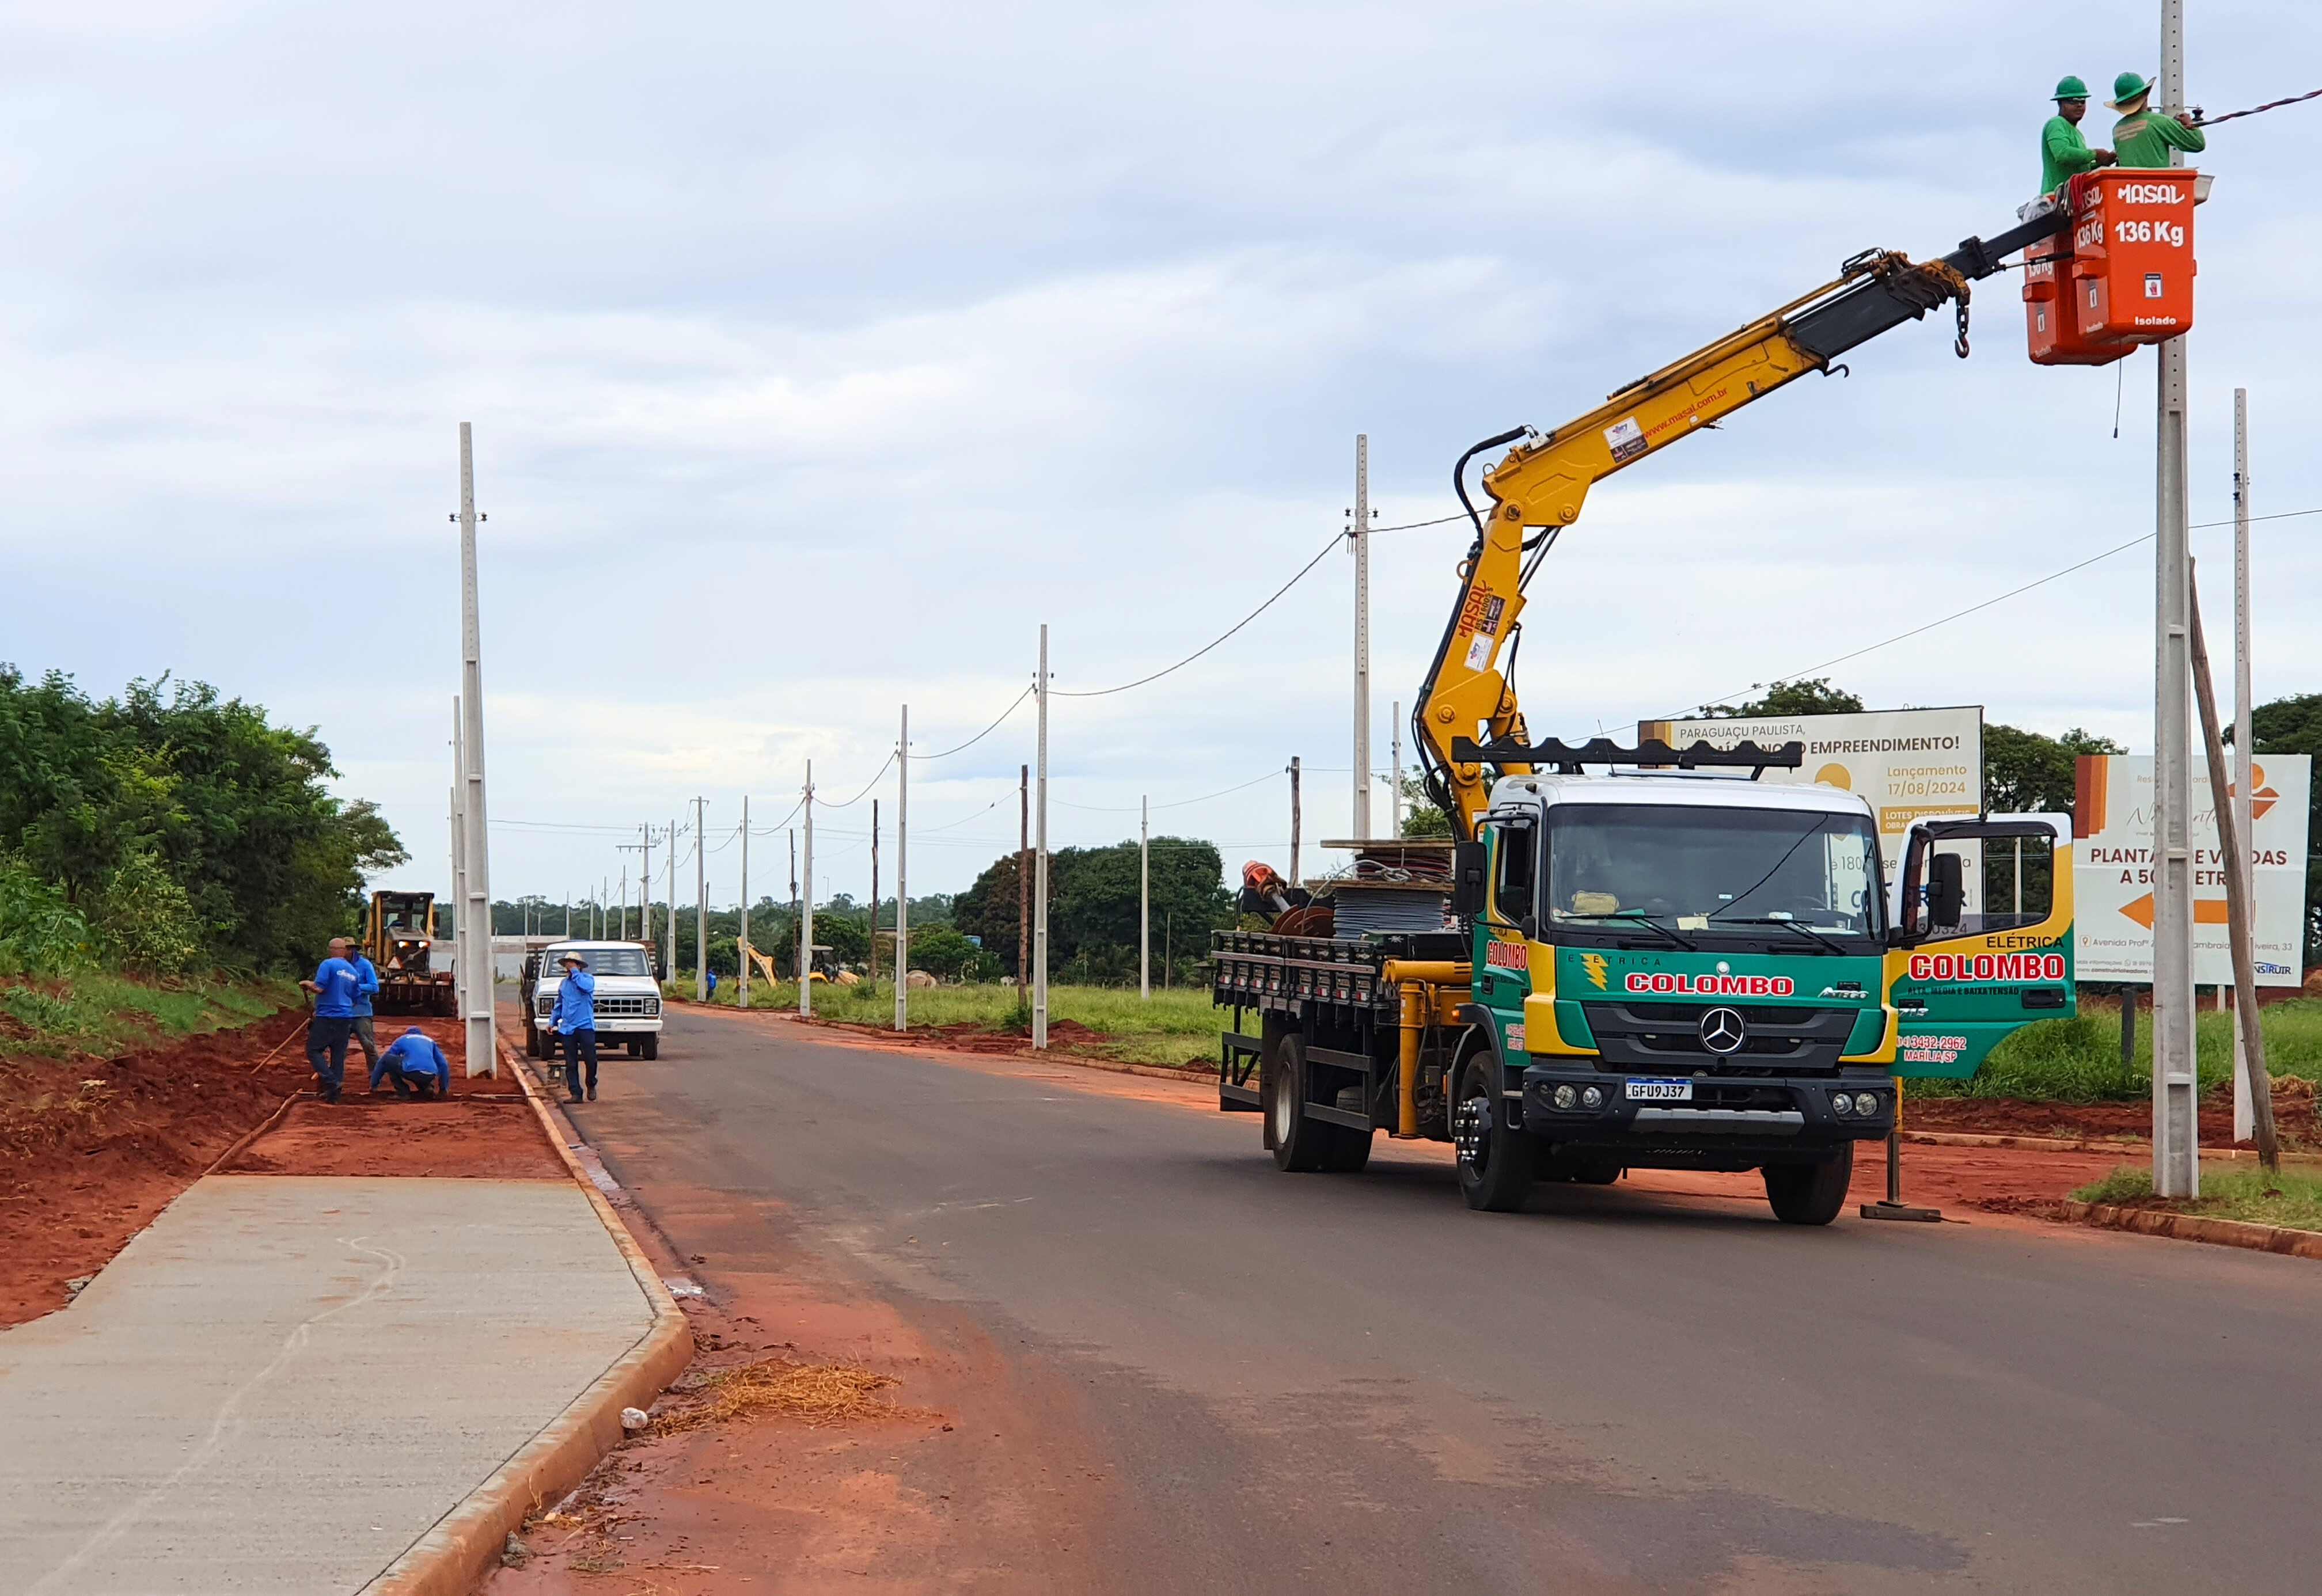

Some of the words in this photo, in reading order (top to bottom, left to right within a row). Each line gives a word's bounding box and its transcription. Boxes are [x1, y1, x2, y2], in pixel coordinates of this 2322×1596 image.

[2080, 186, 2103, 212] SAL
[2118, 184, 2185, 204] MASAL
[2077, 225, 2090, 248] 136
[2091, 219, 2103, 244] Kg
[2115, 221, 2151, 242] 136
[2154, 221, 2184, 247] Kg
[2135, 316, 2177, 325] Isolado
[1644, 387, 1728, 439] www.masal.com.br
[1459, 579, 1488, 638] MASAL
[1680, 727, 1749, 739] PARAGUAÇU
[1752, 724, 1806, 736] PAULISTA,
[1810, 736, 1959, 754] EMPREENDIMENTO!
[1887, 765, 1967, 780] Lançamento
[1888, 780, 1966, 797] 17/08/2024
[1885, 811, 1912, 819] LOTES
[1841, 856, 1862, 870] 180
[2091, 848, 2154, 862] PLANT
[2195, 850, 2205, 864] E
[2120, 869, 2133, 884] A
[1987, 933, 2065, 948] ELÉTRICA
[1486, 940, 1528, 971] COLOMBO
[1909, 953, 2065, 981] COLOMBO
[2254, 964, 2291, 974] NSTRUIR
[1625, 972, 1794, 997] COLOMBO
[1964, 987, 1987, 995] BAIXA
[1911, 1035, 1967, 1050] 3432-2962
[1632, 1085, 1684, 1097] GFU9J37
